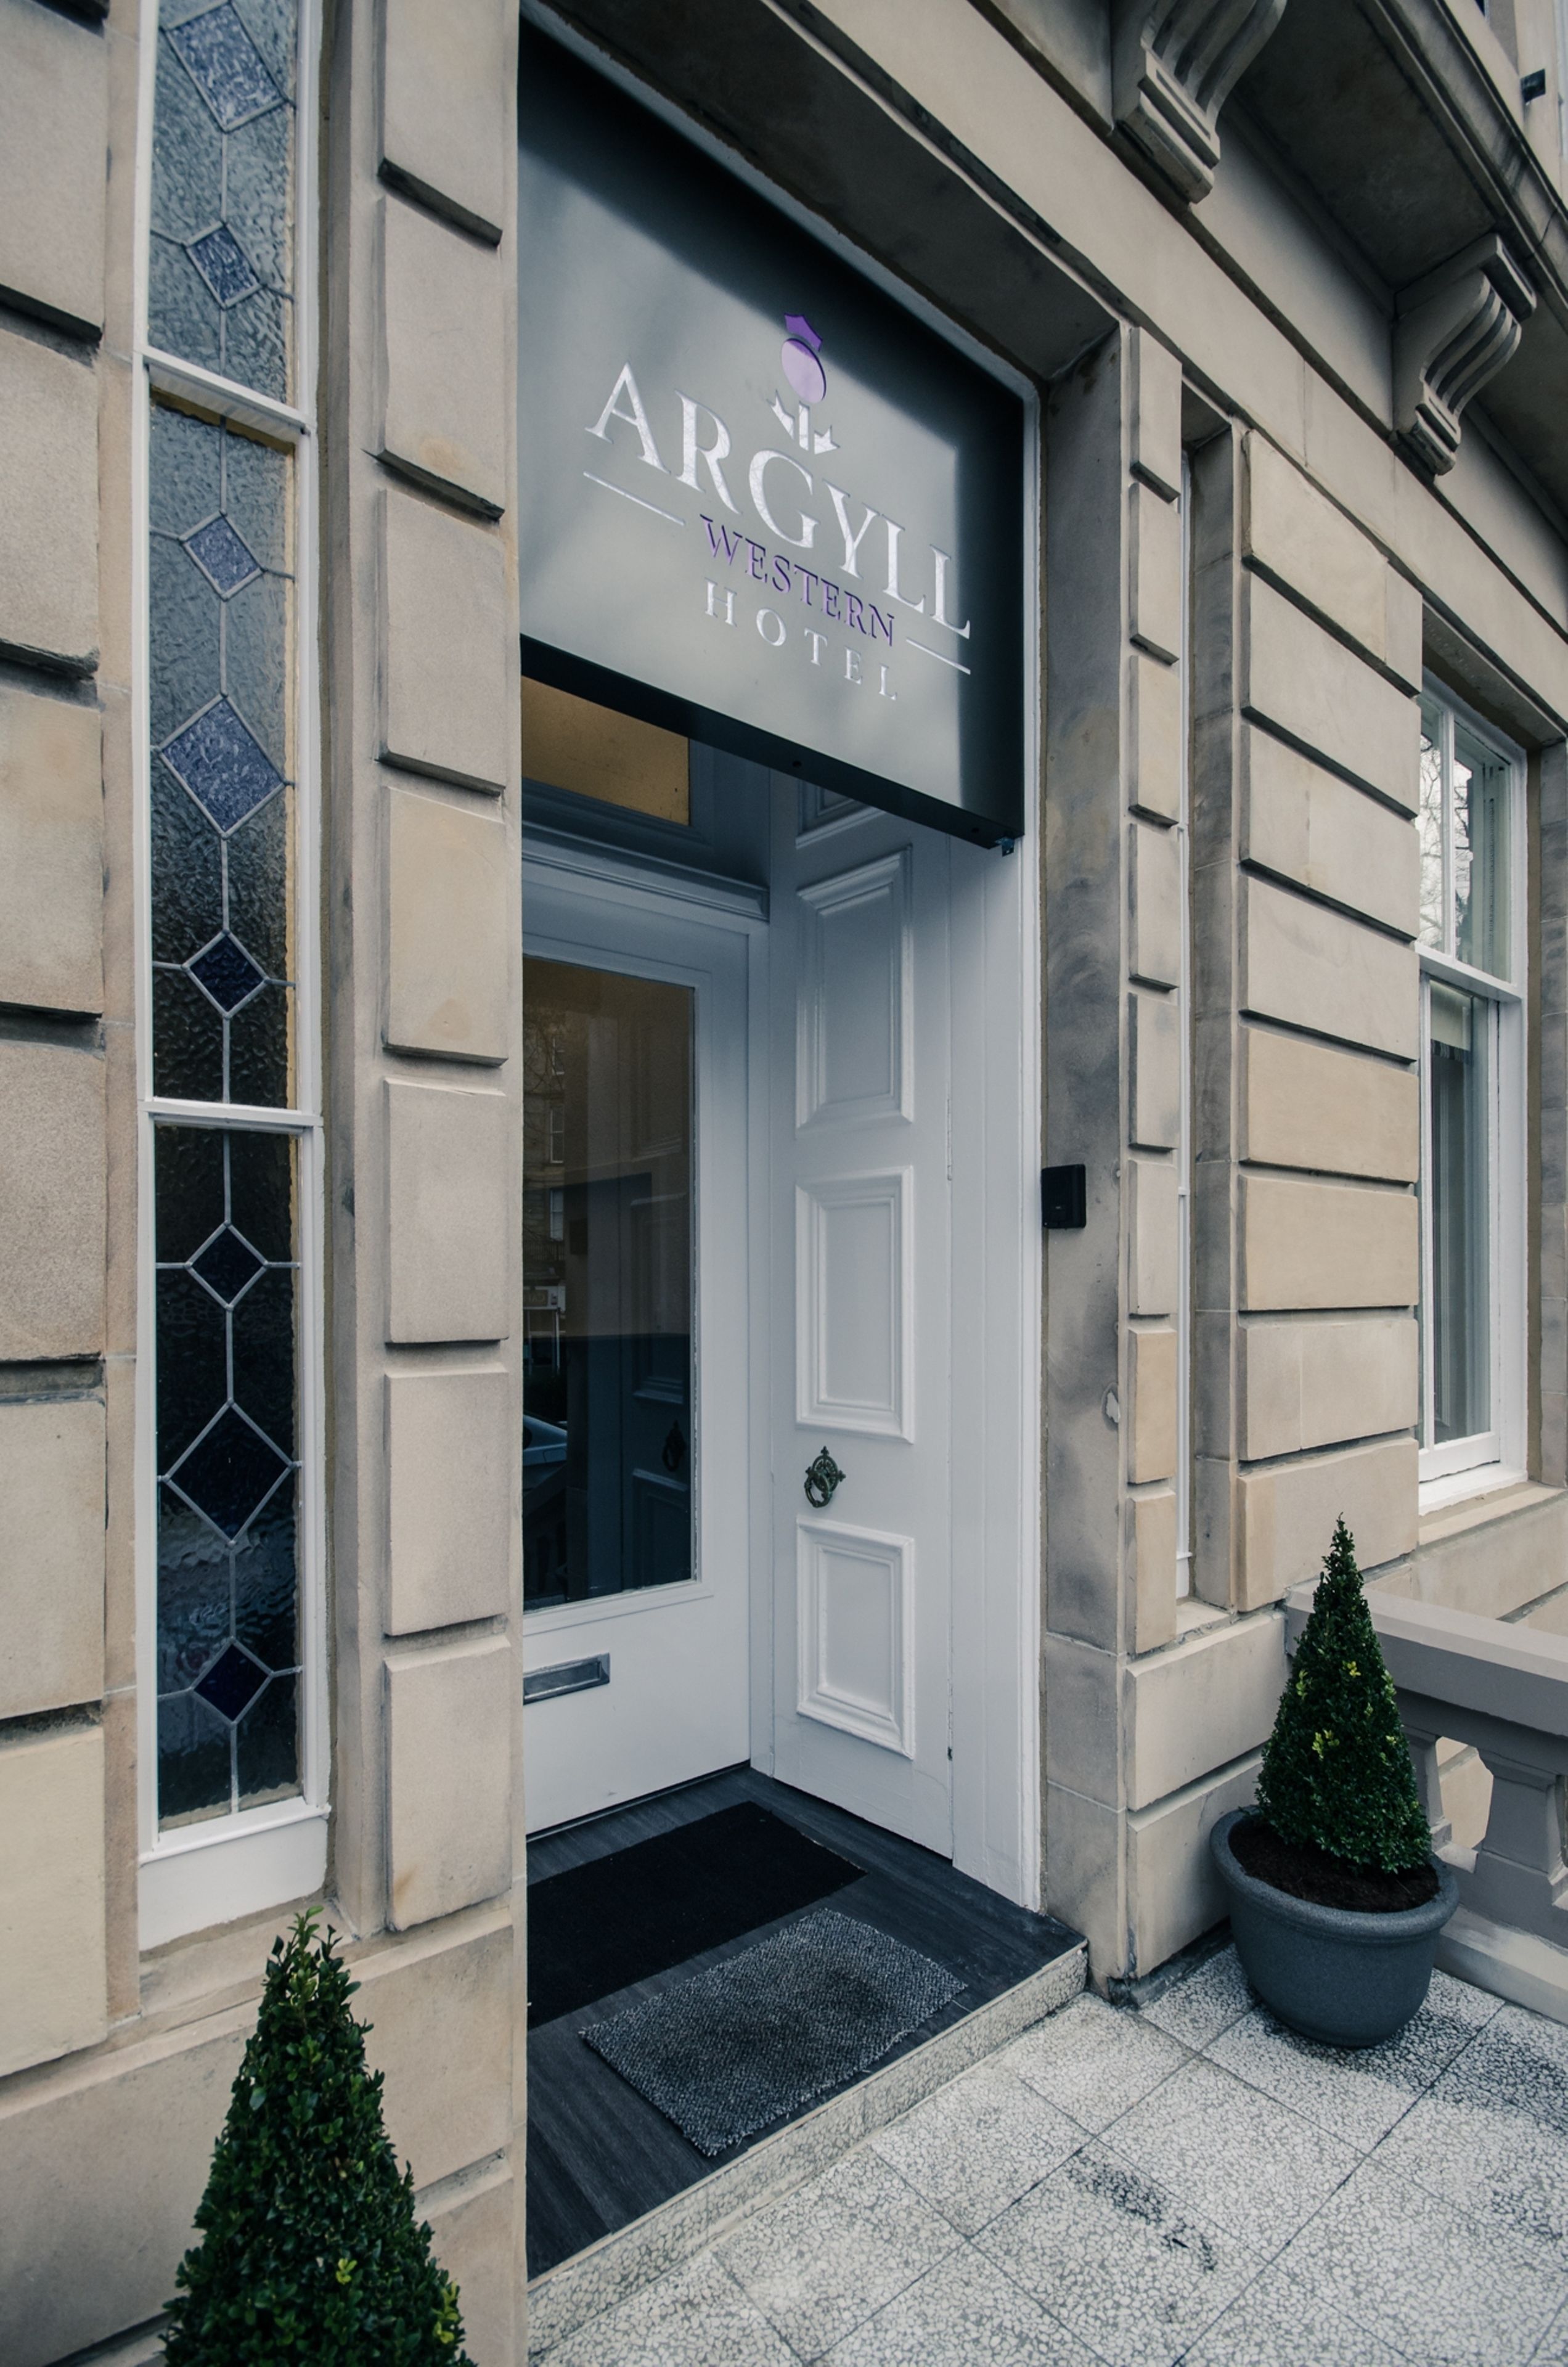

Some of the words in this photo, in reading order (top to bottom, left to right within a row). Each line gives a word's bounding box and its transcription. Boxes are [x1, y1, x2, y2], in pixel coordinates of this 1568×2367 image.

[584, 361, 971, 639] ARGYLL
[700, 514, 895, 647] WESTERN
[704, 578, 897, 700] HOTEL
